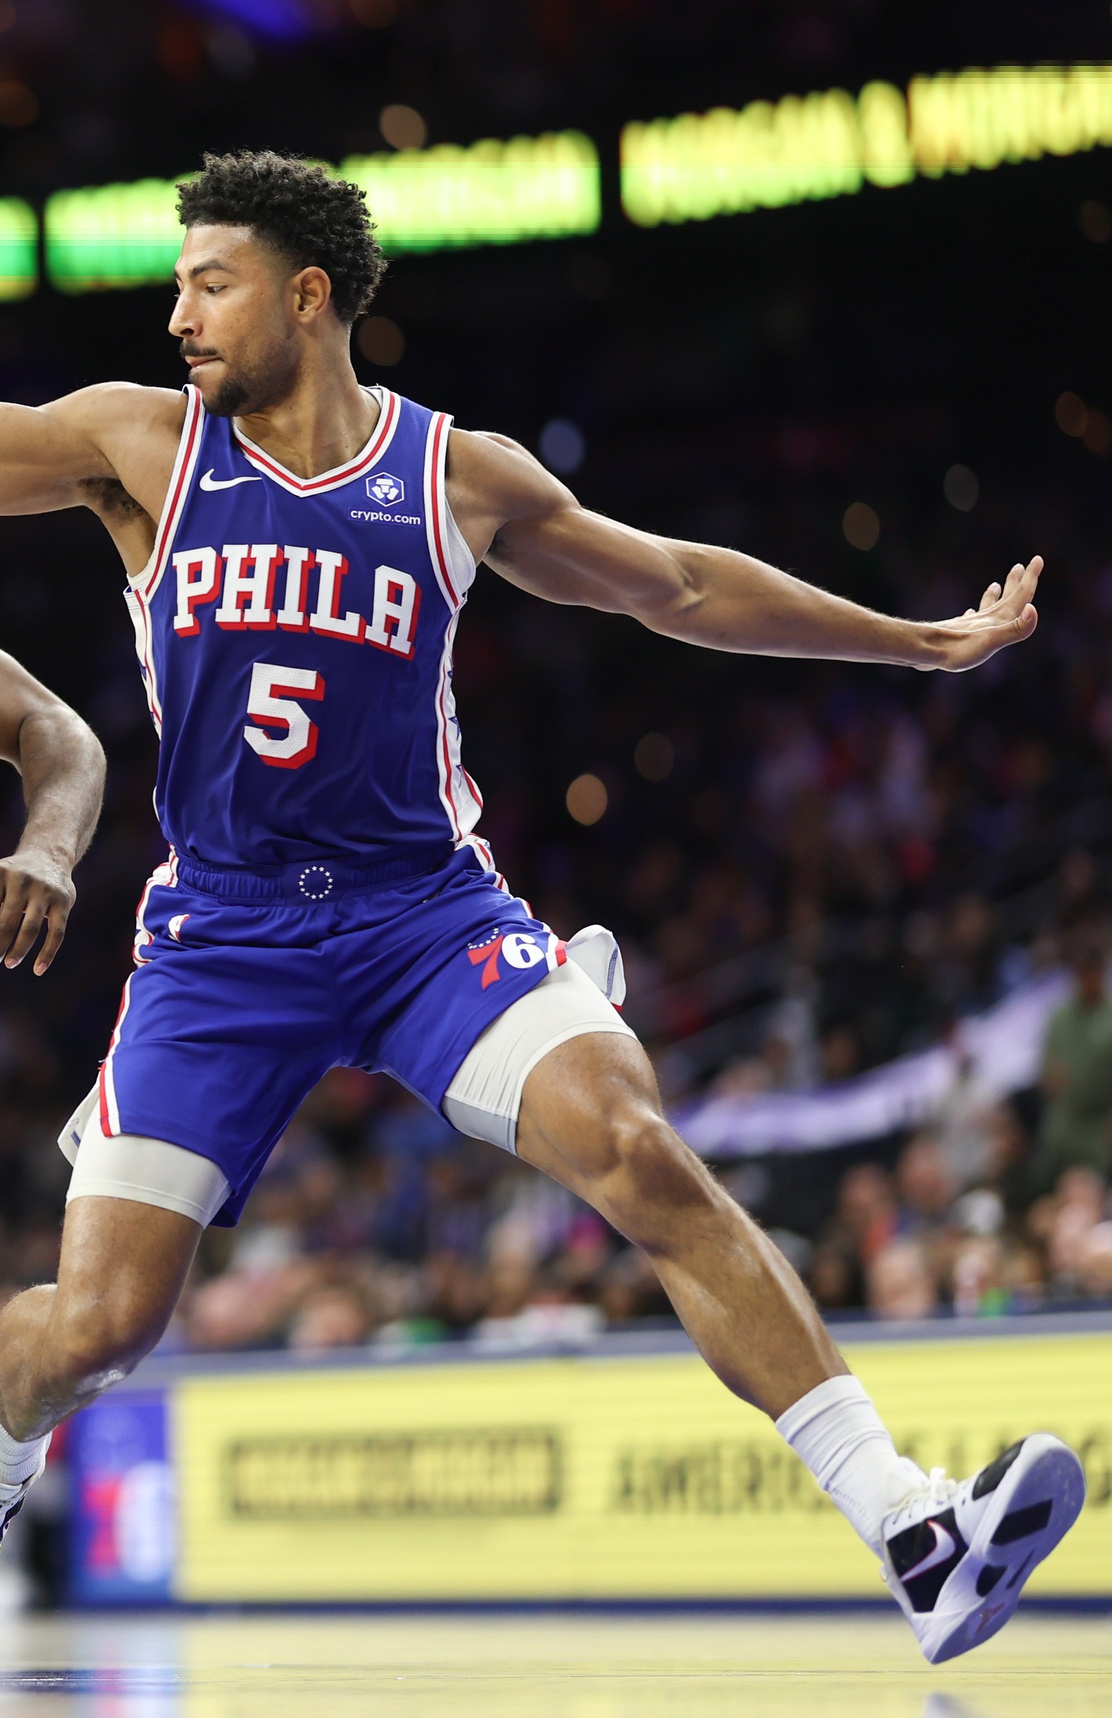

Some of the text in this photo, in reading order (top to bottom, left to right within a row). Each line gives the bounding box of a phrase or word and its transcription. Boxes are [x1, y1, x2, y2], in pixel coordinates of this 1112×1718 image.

[350, 510, 421, 525] crypto.com
[172, 543, 422, 662] PHILA
[243, 662, 326, 770] 5
[467, 932, 547, 992] 76
